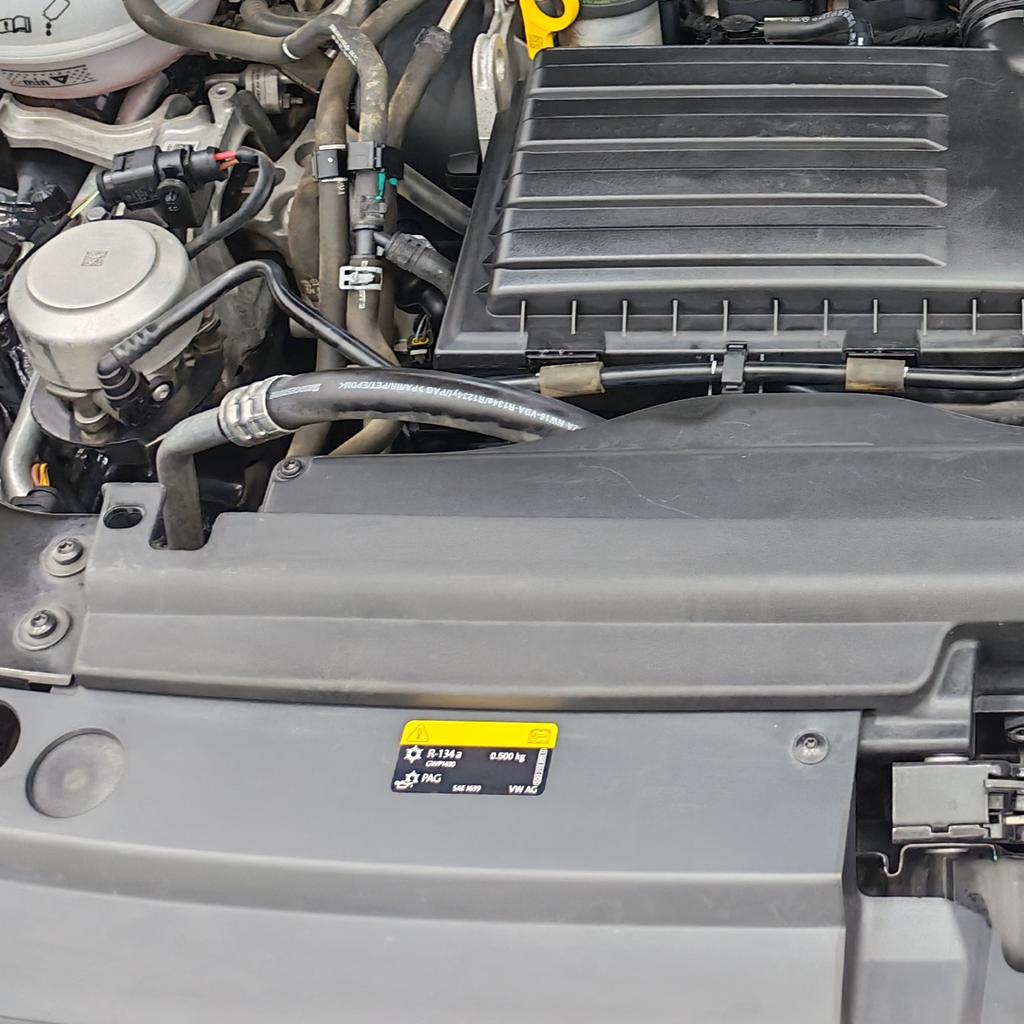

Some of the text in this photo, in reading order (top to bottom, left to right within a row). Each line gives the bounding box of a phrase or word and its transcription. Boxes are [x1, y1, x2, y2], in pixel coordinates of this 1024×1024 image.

[23, 78, 50, 86] min
[490, 752, 526, 763] 0.500 kg
[421, 773, 442, 783] PAG
[509, 785, 537, 794] VW AG
